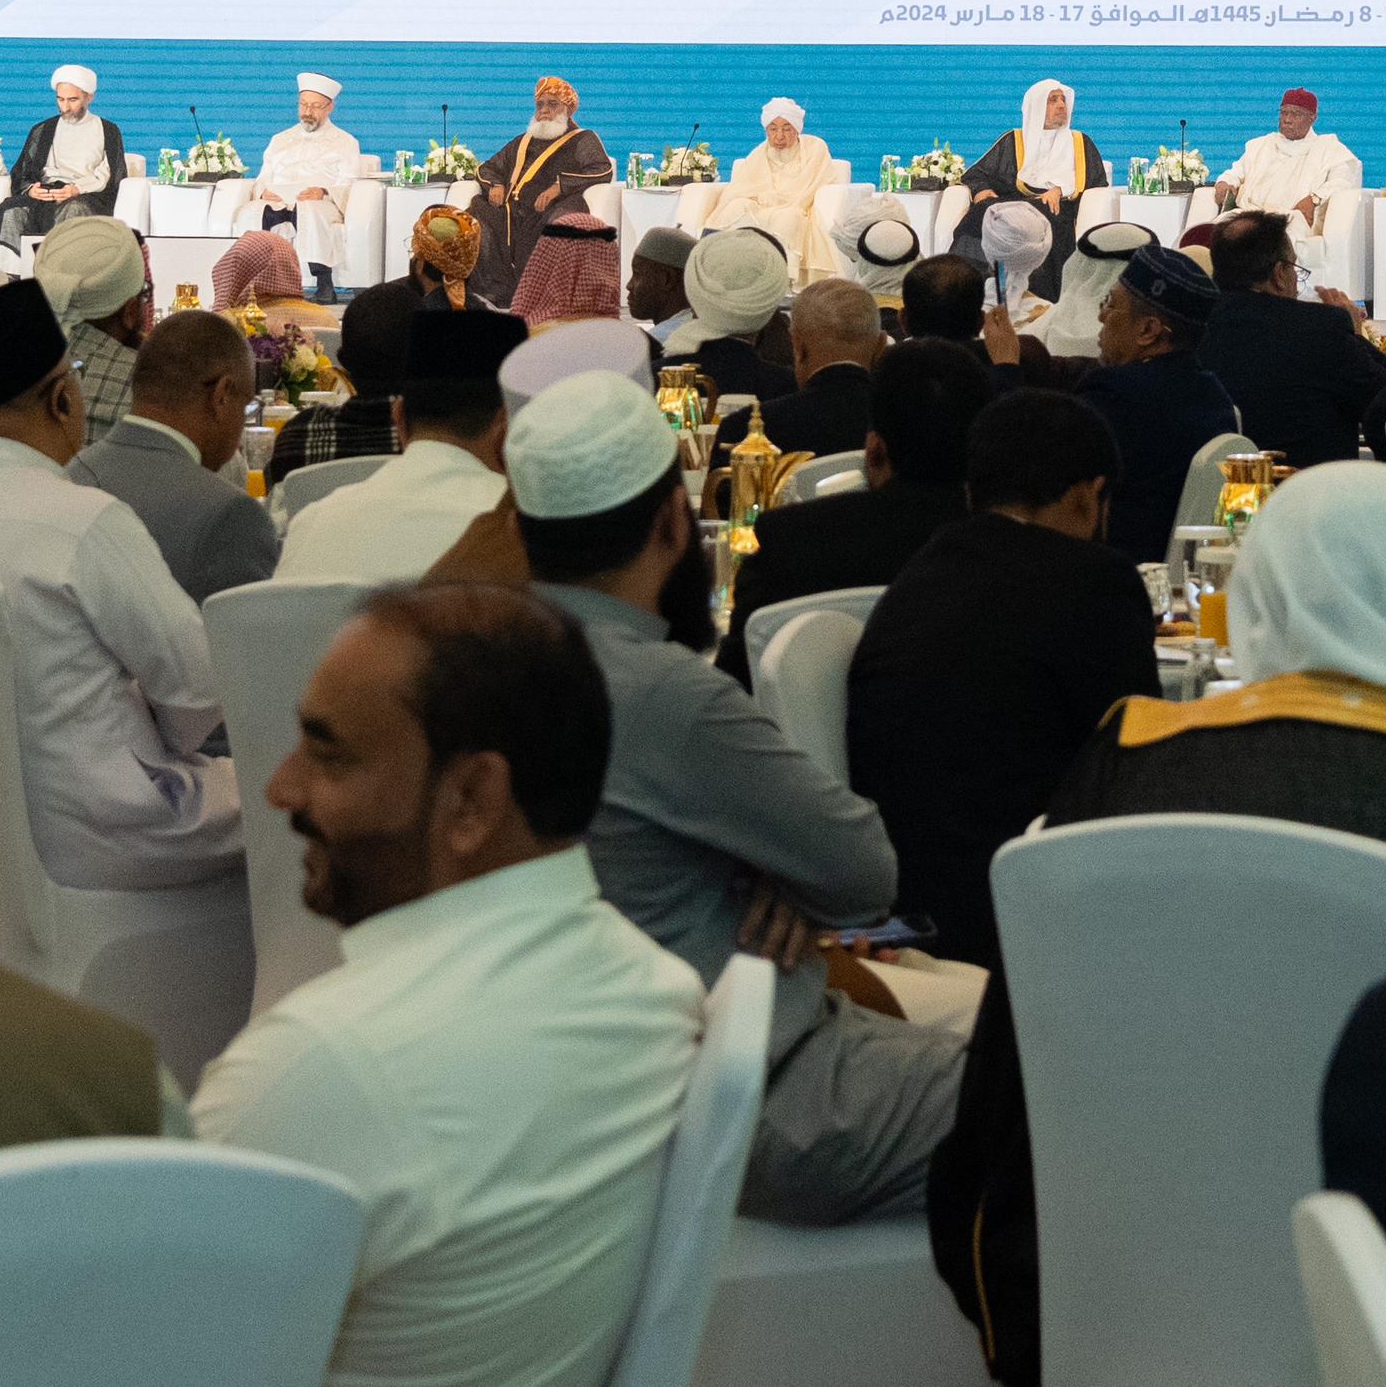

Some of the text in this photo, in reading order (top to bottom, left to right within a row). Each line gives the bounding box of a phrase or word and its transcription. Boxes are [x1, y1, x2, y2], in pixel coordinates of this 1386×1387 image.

[949, 4, 1015, 27] مارس
[1020, 4, 1045, 22] 18
[1059, 4, 1084, 22] 17
[1089, 4, 1184, 27] الموافق
[1264, 4, 1354, 28] رمضان
